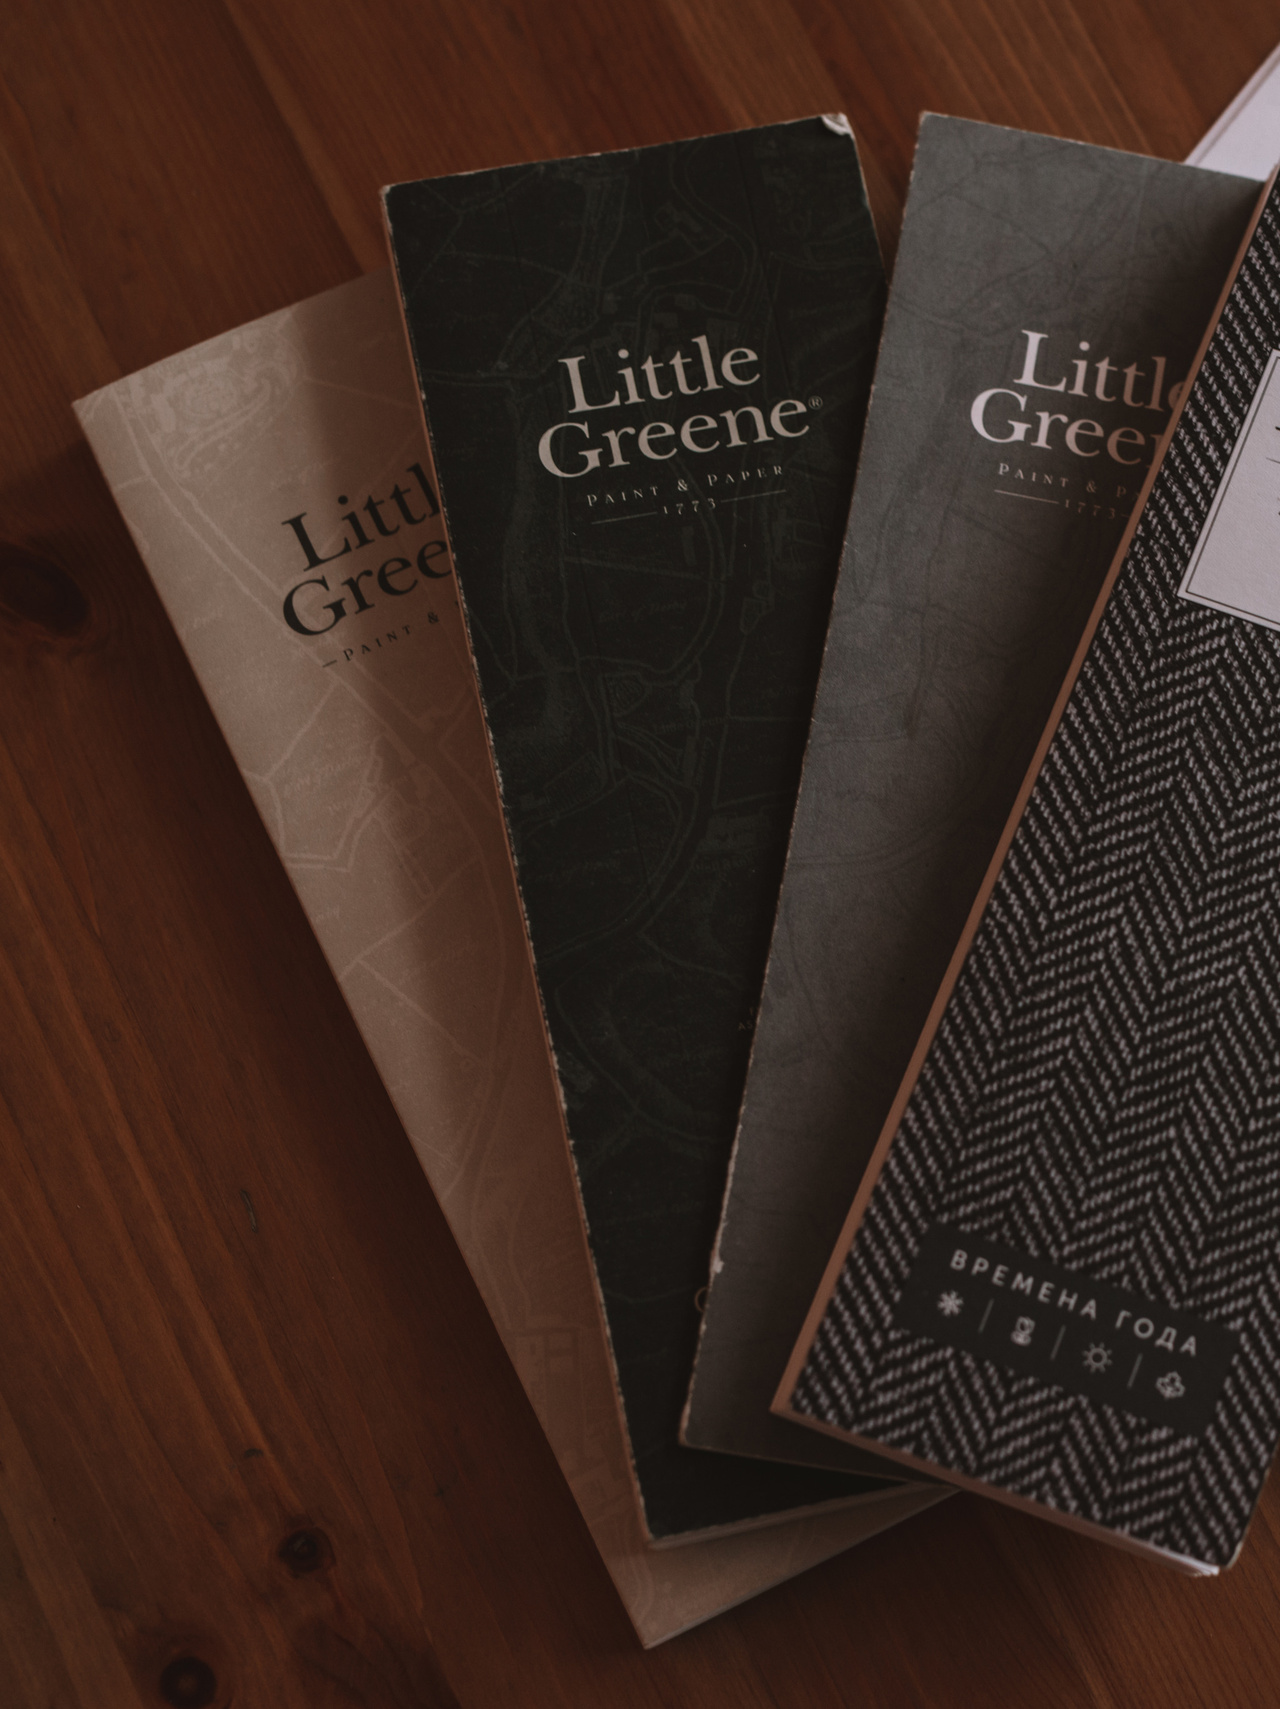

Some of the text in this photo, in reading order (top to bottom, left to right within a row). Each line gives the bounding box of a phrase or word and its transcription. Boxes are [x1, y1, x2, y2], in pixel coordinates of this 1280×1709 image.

[558, 335, 760, 413] Little
[970, 388, 1163, 469] Gree
[281, 462, 441, 573] Littl
[587, 465, 784, 508] PAINT & PAPER
[663, 497, 717, 516] 1773
[998, 463, 1069, 488] PAINT
[1086, 480, 1099, 494] &
[283, 540, 453, 637] Gree
[343, 611, 440, 662] PAINT &
[950, 1248, 1198, 1358] ВРЕМЕНА ГОДА
